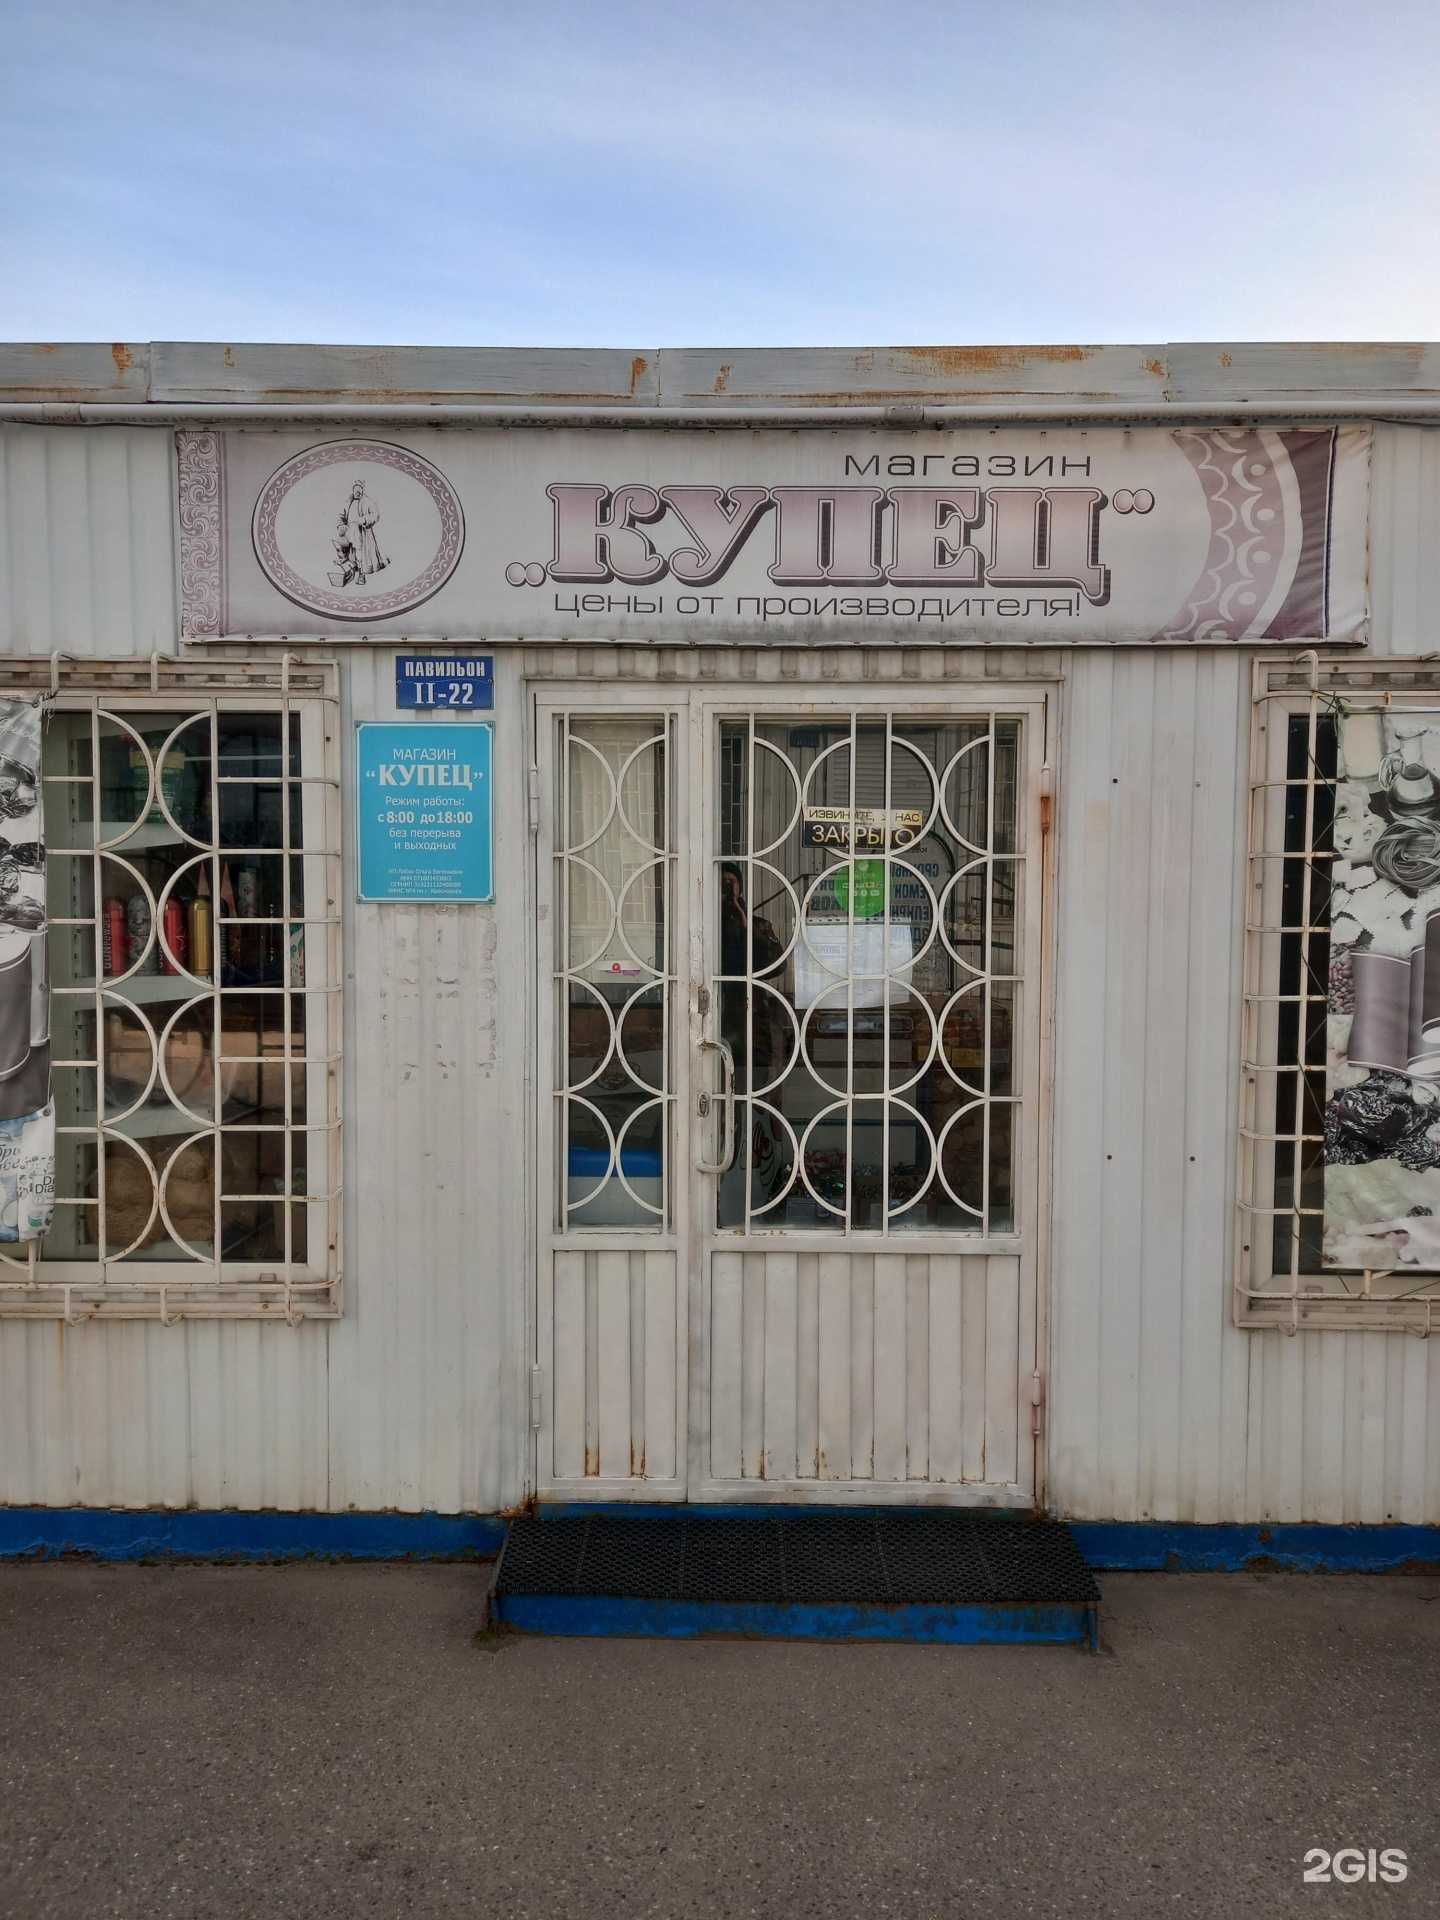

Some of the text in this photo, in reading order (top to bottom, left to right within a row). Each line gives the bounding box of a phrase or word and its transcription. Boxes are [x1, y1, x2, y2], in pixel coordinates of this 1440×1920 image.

[845, 454, 1091, 477] магазин
[554, 592, 1081, 623] цены от производителя!
[405, 661, 486, 677] ПАВИЛЬОН
[393, 748, 457, 761] МАГАЗИН
[385, 795, 465, 809] Режим работы:
[386, 811, 415, 824] 8:00
[420, 813, 435, 825] до
[437, 811, 473, 824] 18:00
[895, 812, 920, 823] НАС
[389, 827, 462, 841] без перерыва
[394, 841, 457, 852] и выходных
